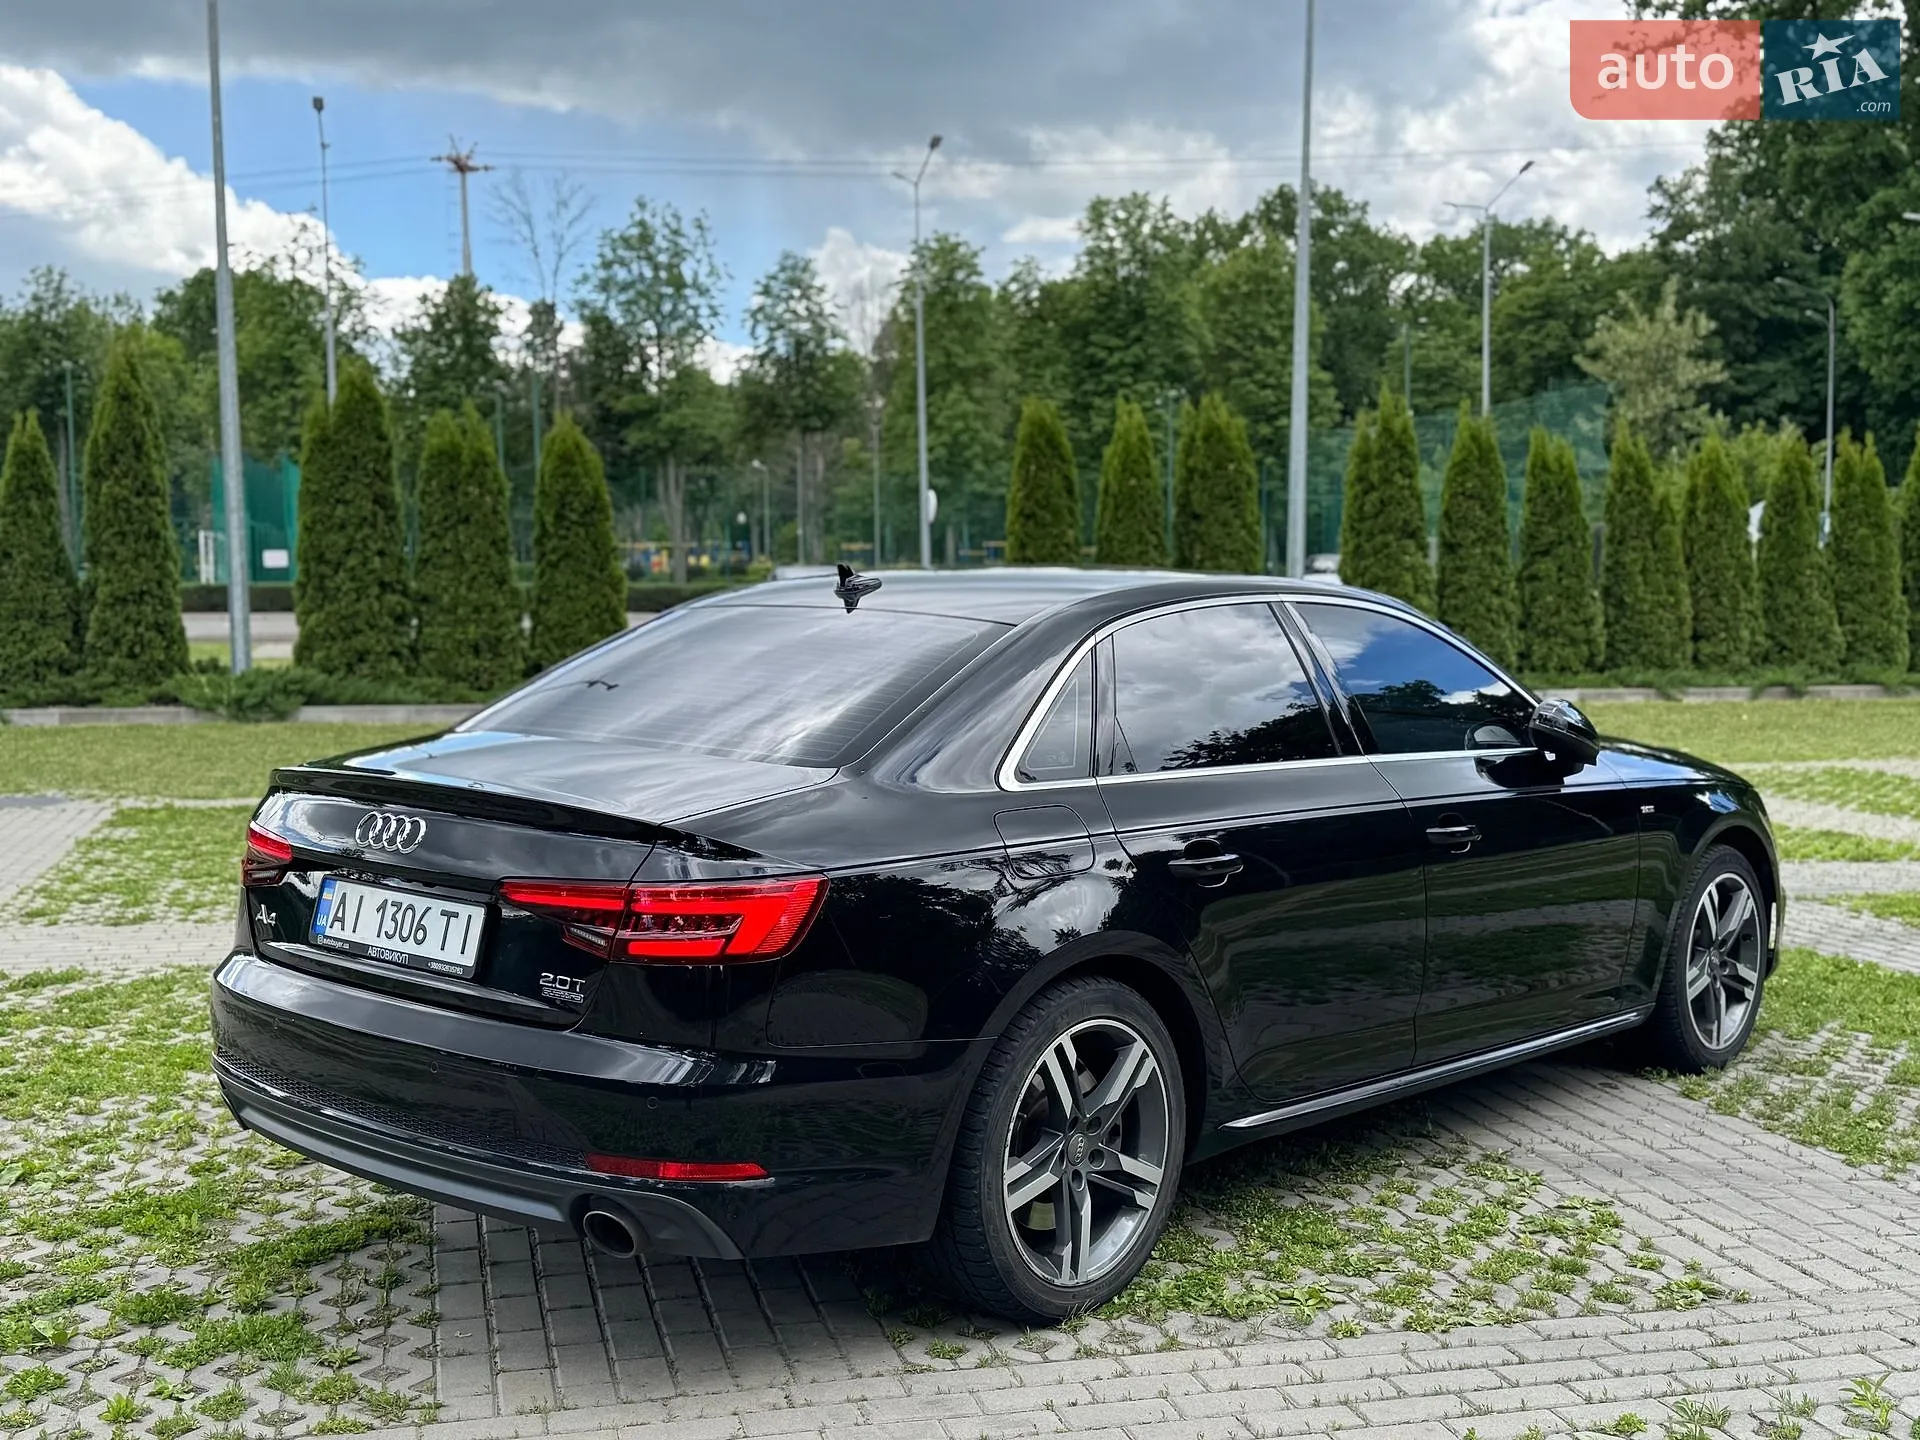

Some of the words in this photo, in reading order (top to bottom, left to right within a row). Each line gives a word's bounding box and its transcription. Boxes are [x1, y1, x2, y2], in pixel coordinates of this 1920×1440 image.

[255, 904, 277, 926] A4
[316, 914, 327, 926] UA
[329, 892, 364, 933] AI
[376, 898, 432, 945] 1306
[440, 909, 472, 955] TI
[367, 946, 409, 965] АВТОВИКУП
[539, 972, 586, 992] 2.0T
